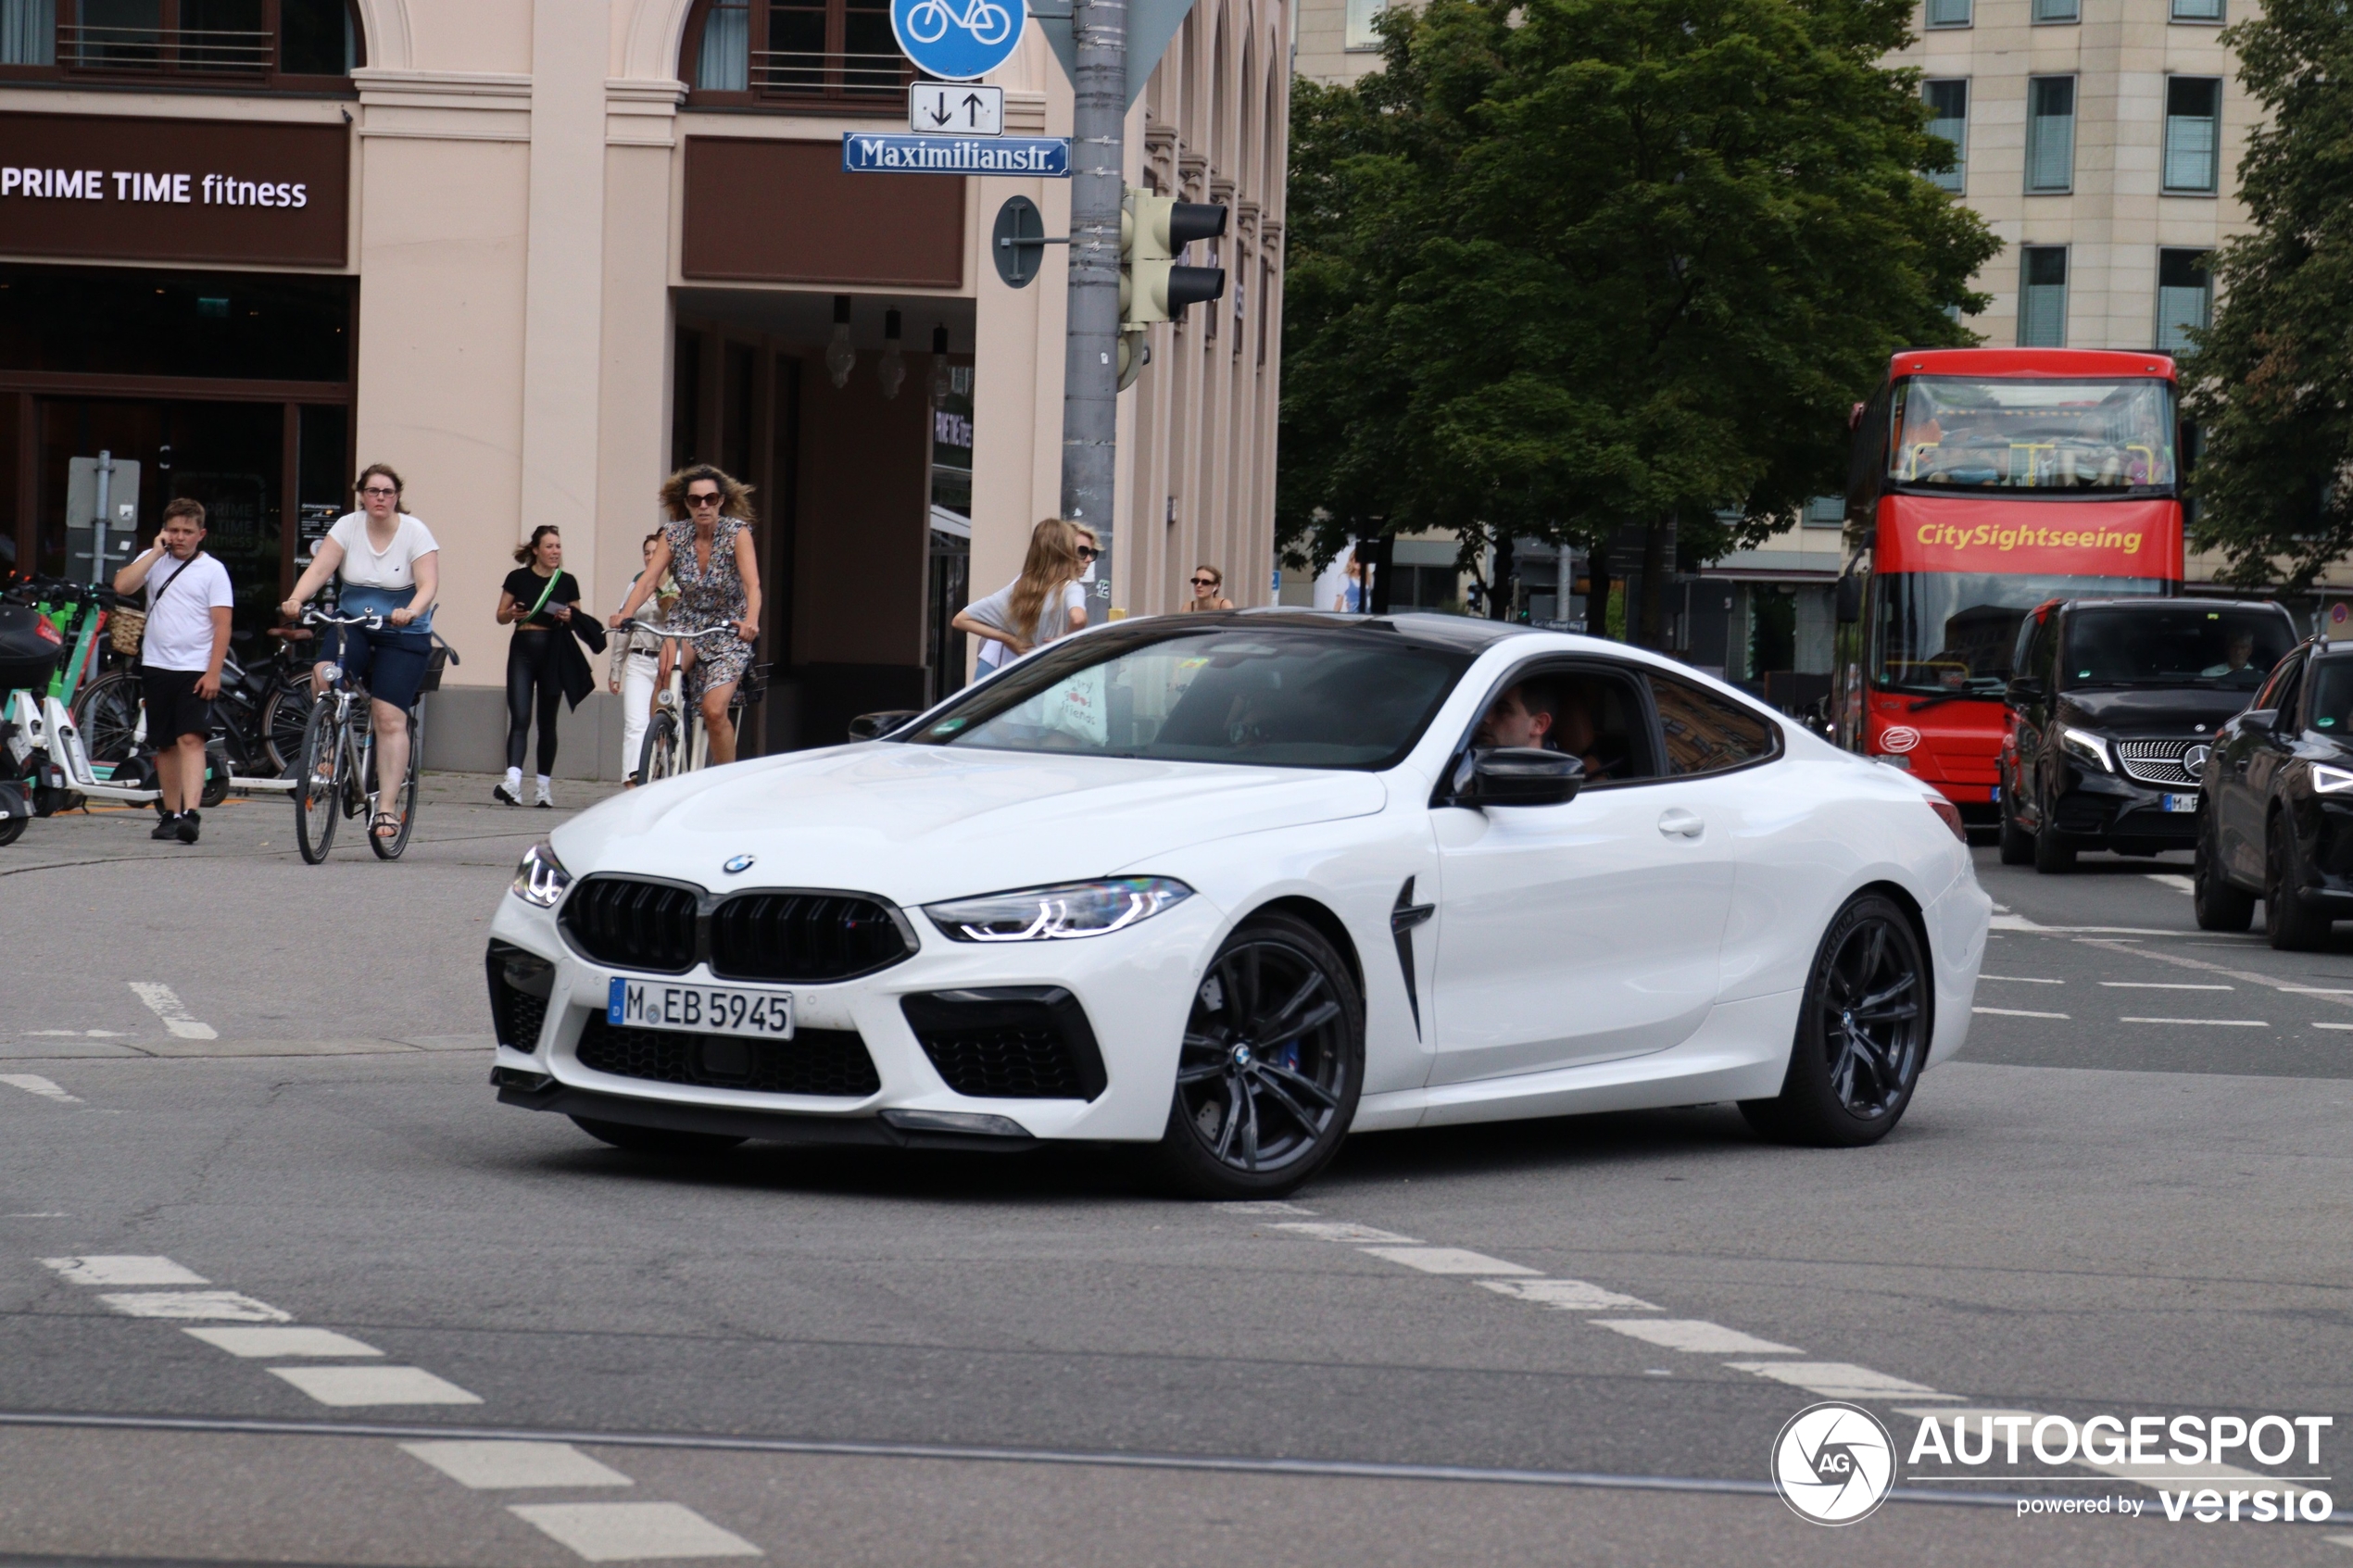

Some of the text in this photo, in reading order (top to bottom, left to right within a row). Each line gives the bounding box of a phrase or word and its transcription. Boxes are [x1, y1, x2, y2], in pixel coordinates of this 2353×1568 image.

[860, 139, 1054, 170] Maximilianstr.
[1, 167, 308, 208] PRIME TIME fitness
[206, 502, 253, 517] PRIME
[217, 520, 253, 533] TIME
[1917, 523, 2143, 554] CitySightseeing
[626, 985, 644, 1020] M
[664, 988, 701, 1024] EB
[710, 993, 787, 1032] 5945
